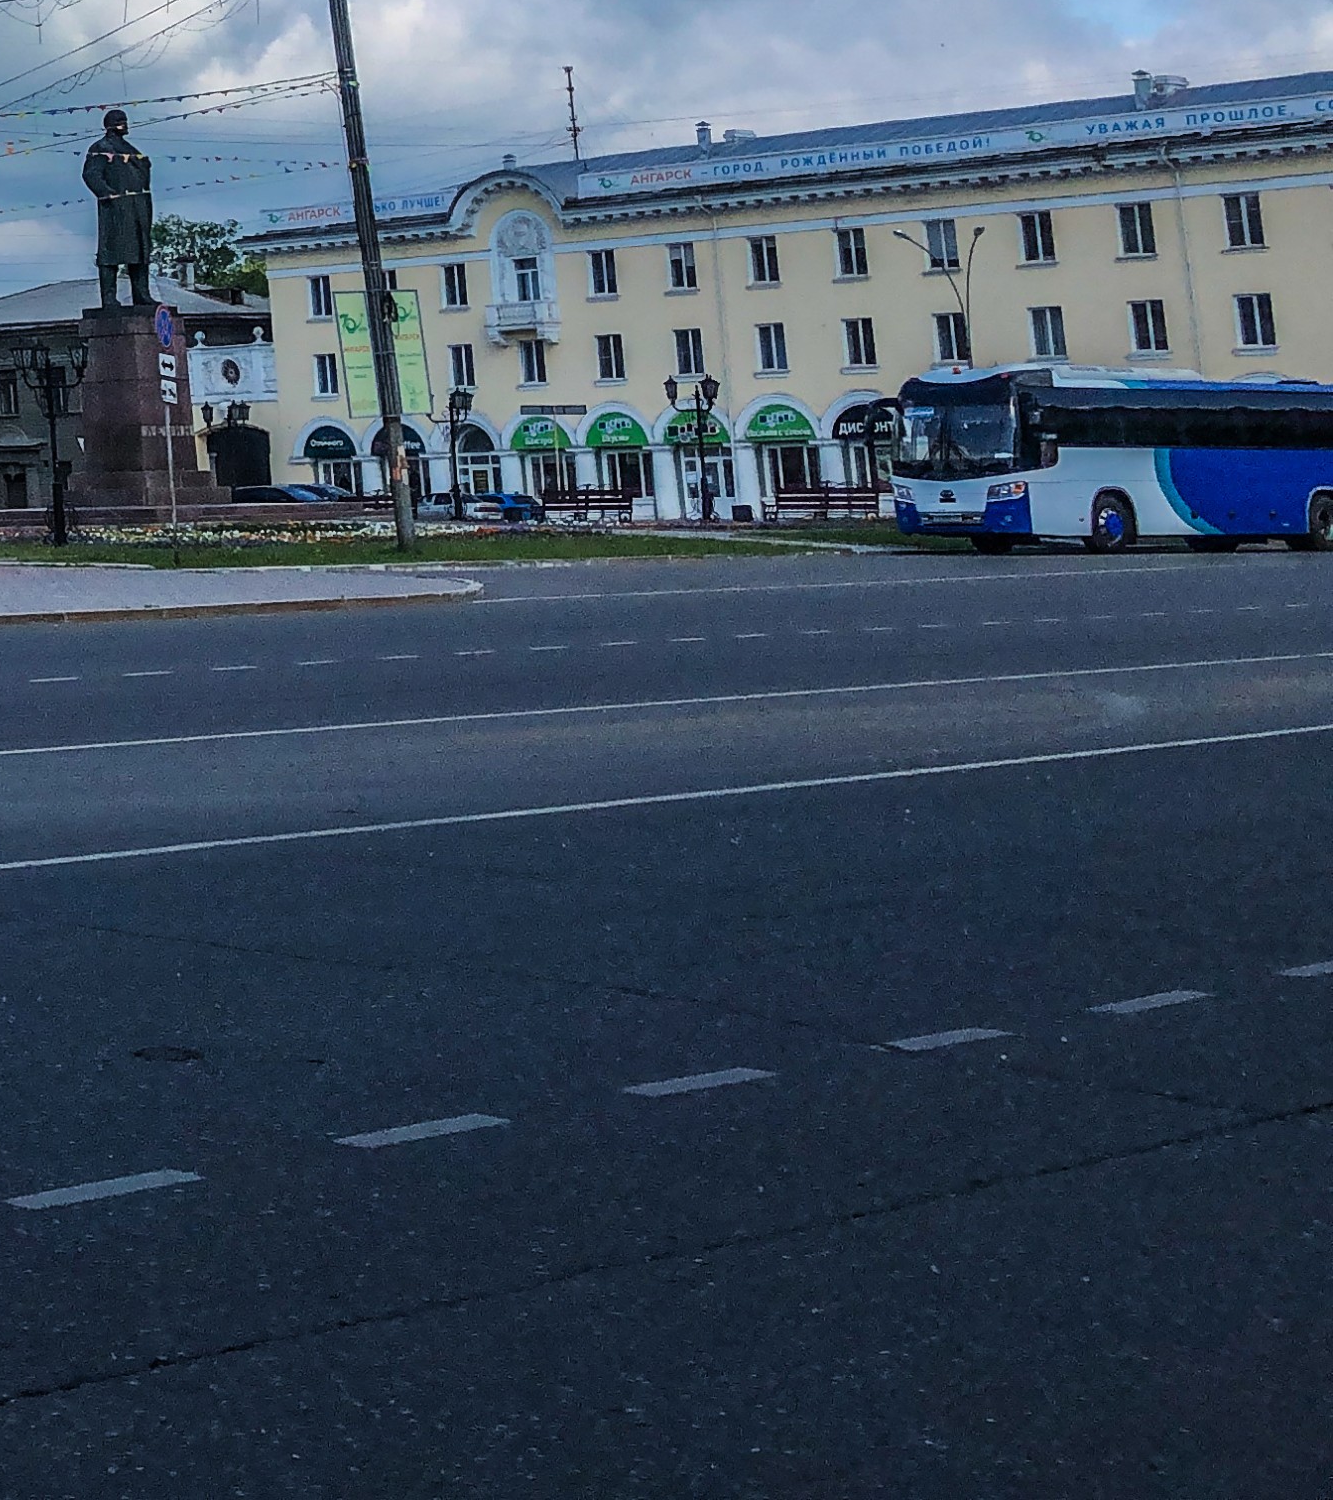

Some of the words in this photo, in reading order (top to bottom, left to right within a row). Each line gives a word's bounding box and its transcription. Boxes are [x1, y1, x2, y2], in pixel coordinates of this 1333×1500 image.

[1086, 117, 1165, 135] УВАЖАЯ
[1186, 105, 1295, 125] ПРОШЛОЕ,
[631, 169, 692, 186] АНГАРСК
[781, 147, 886, 168] РОЖДЁННЫЙ
[899, 137, 990, 157] ПОБЕДОЙ!
[288, 206, 341, 221] АНГАРСК
[401, 196, 444, 210] ЛУЧШЕ!
[838, 420, 894, 436] ДИСОНТ
